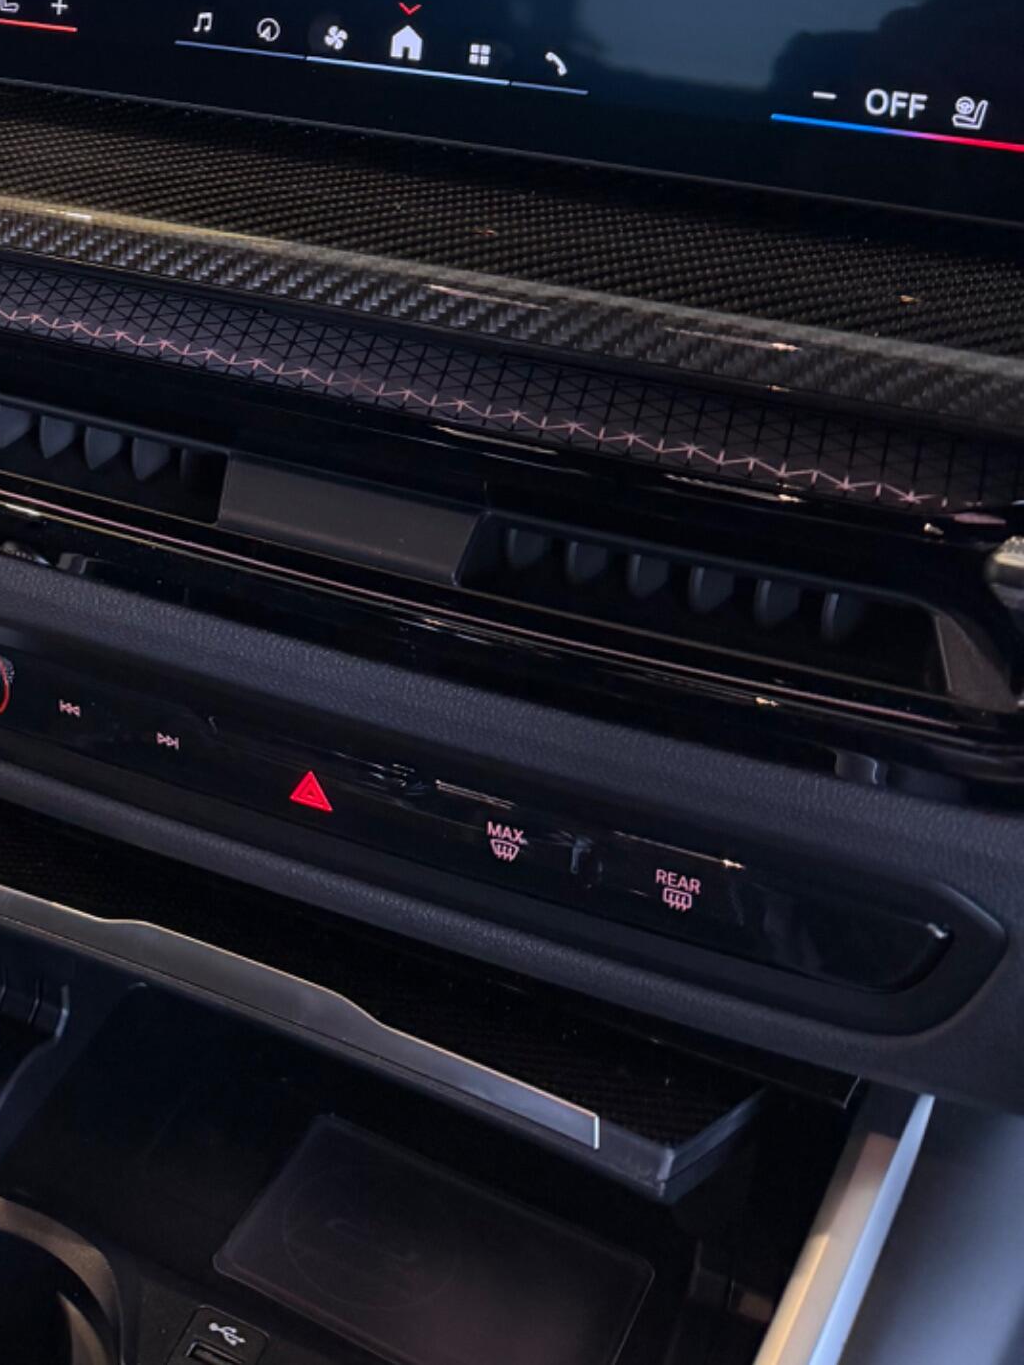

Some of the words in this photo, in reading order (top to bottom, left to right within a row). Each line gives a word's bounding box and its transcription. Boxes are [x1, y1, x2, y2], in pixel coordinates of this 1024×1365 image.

[865, 88, 928, 120] OFF
[486, 821, 524, 843] MAX
[655, 868, 701, 895] REAR
